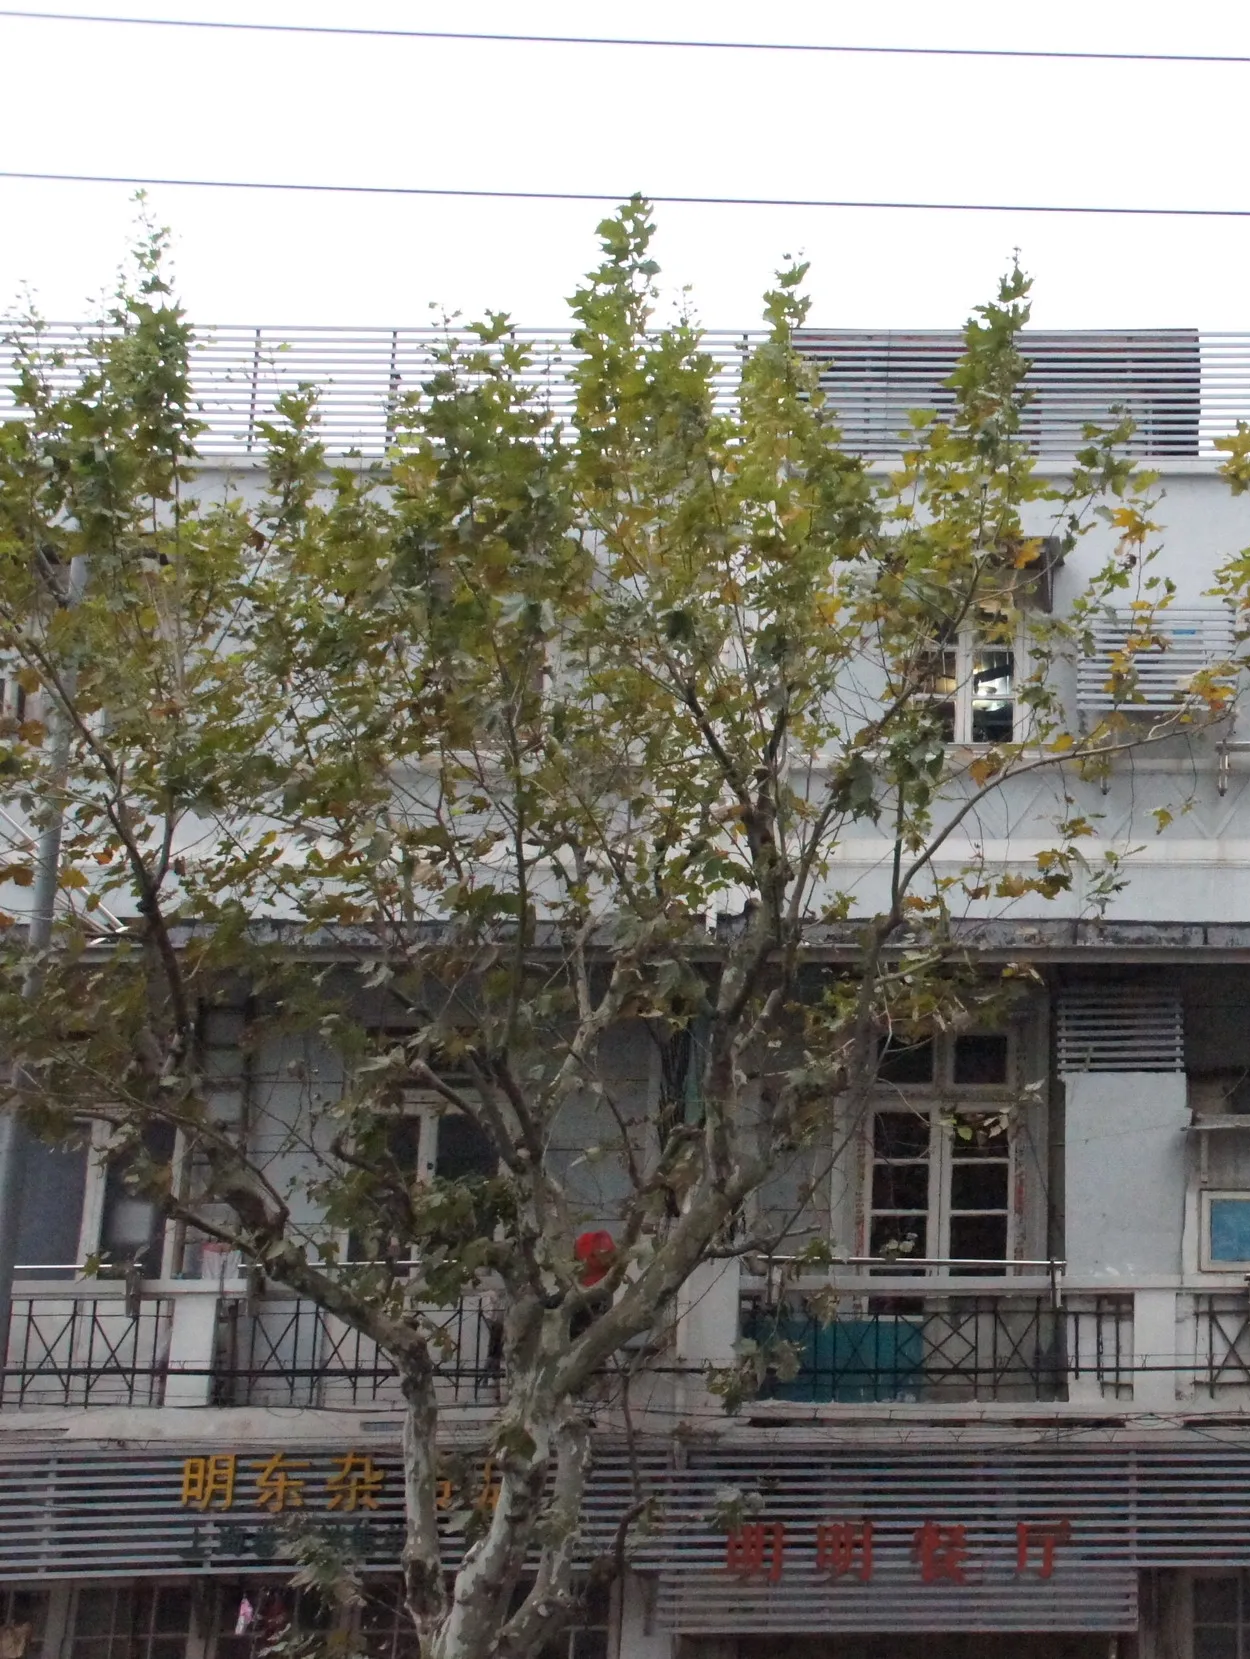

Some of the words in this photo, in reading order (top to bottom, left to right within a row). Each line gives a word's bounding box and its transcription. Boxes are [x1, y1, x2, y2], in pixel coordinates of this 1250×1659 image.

[180, 1450, 518, 1513] 明东杂
[726, 1519, 1072, 1586] 明明餐厅
